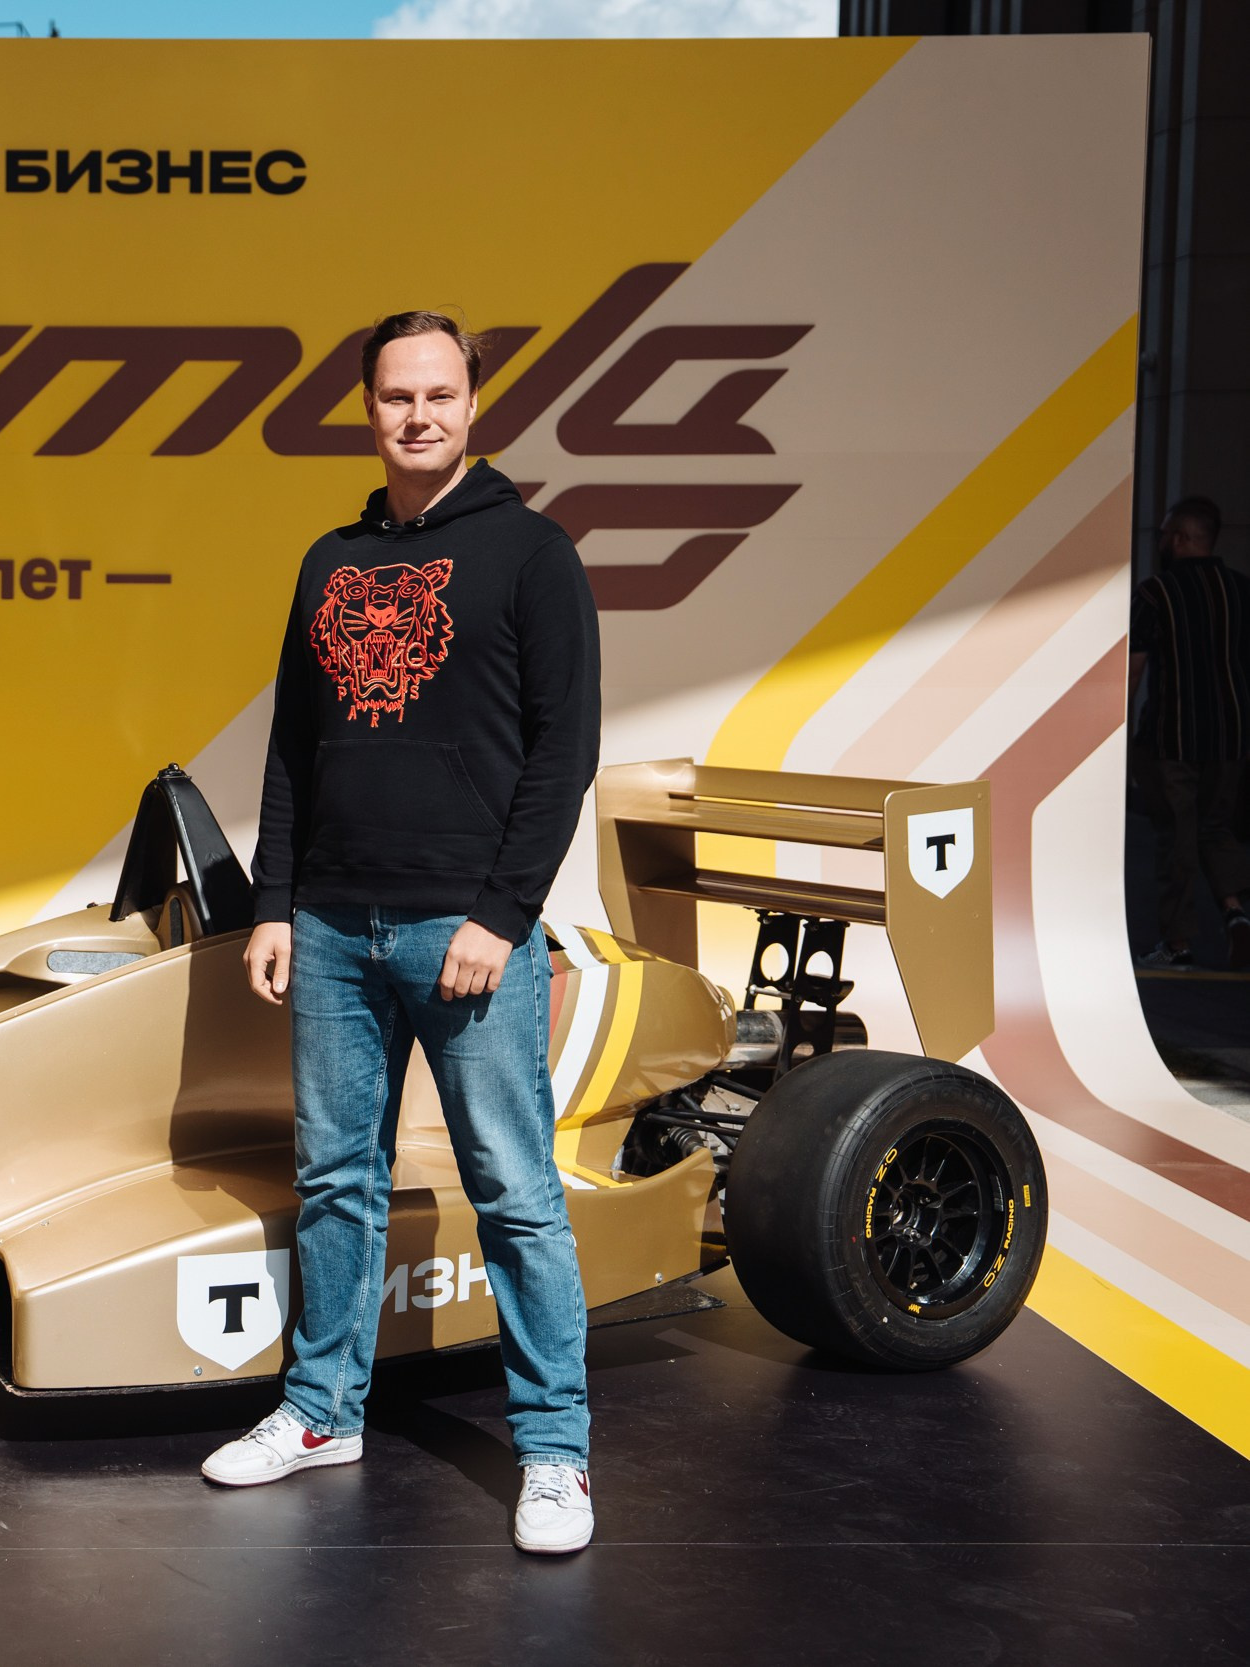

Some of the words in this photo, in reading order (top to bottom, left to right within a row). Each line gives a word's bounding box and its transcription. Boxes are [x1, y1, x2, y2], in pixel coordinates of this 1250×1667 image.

[5, 149, 307, 195] БИЗНЕС
[334, 641, 428, 672] KENZO
[337, 685, 420, 728] PARIS
[865, 1187, 877, 1239] RACING
[1003, 1199, 1015, 1249] RACING
[381, 1252, 494, 1314] ИЗН
